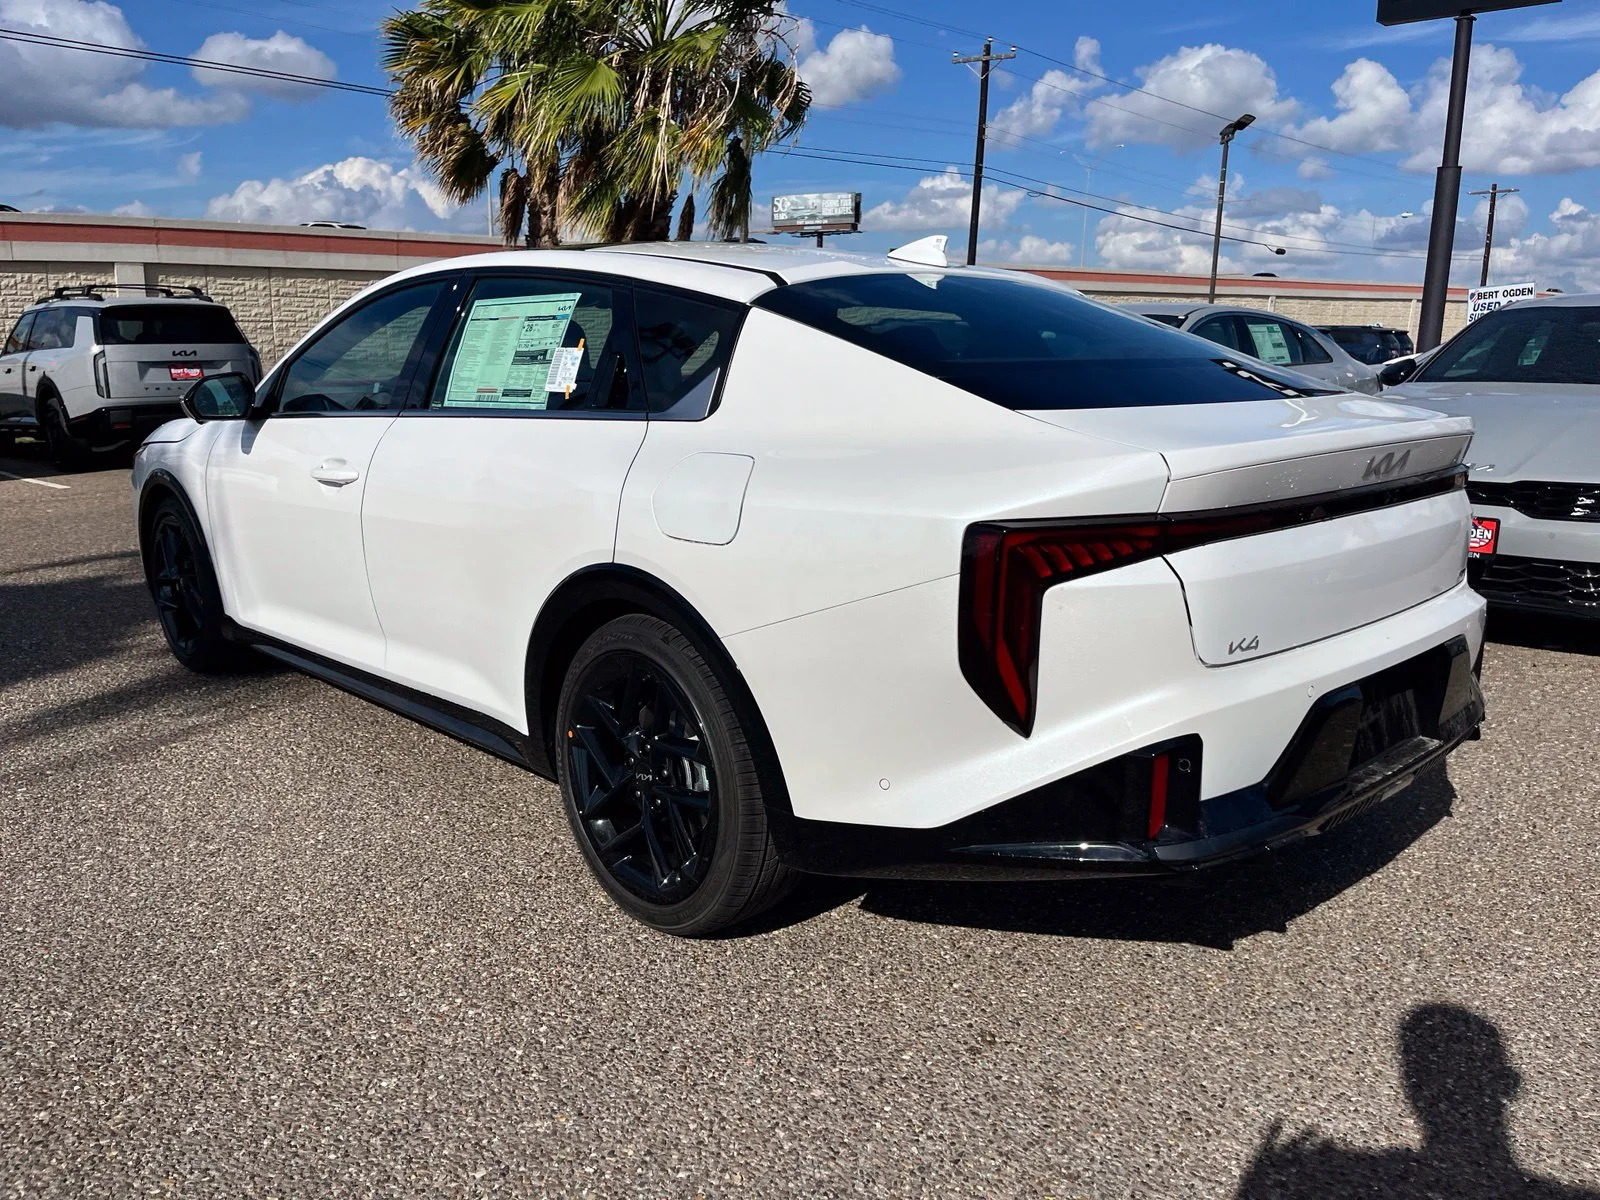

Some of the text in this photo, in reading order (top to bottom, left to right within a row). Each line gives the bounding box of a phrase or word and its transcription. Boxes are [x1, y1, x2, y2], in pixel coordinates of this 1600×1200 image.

[1477, 287, 1534, 300] BERT OGDEN
[1473, 302, 1501, 312] USED
[1362, 449, 1411, 481] KIA
[1471, 528, 1492, 540] DEN
[1228, 635, 1259, 655] K4
